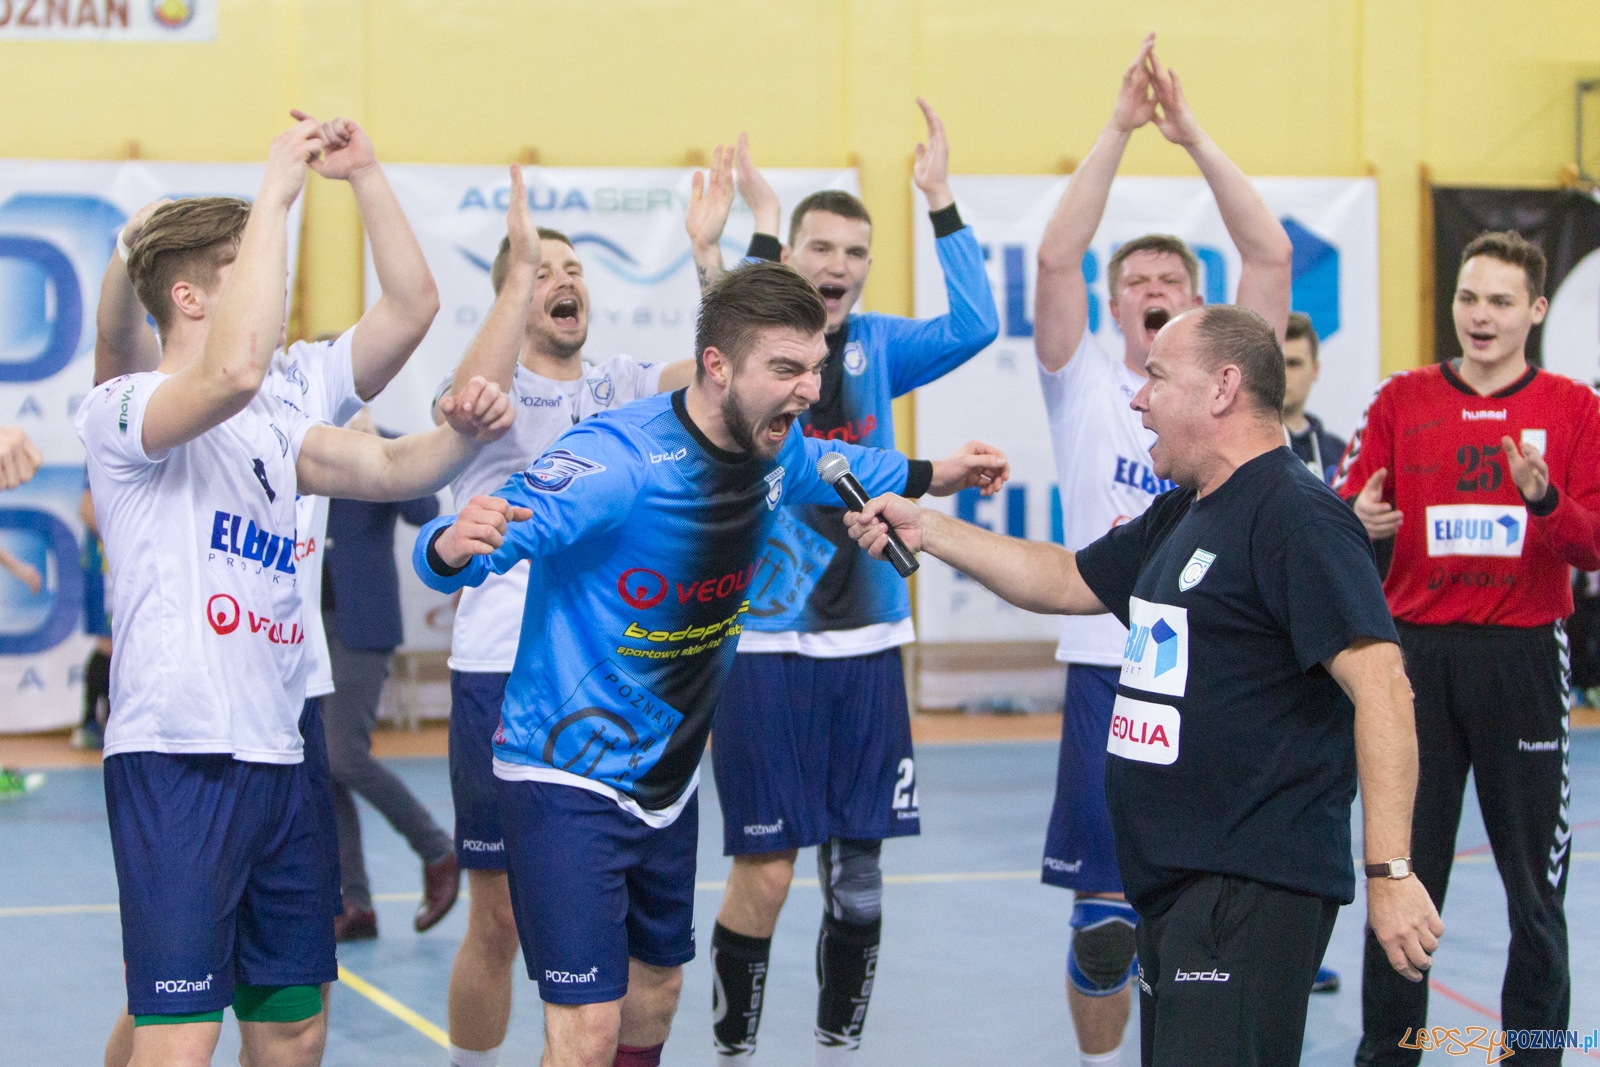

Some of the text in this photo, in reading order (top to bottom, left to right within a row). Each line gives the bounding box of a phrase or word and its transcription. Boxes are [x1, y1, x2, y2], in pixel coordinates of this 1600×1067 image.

[1462, 408, 1507, 421] hummel
[1114, 455, 1178, 495] ELB
[1456, 444, 1503, 492] 25
[1434, 518, 1494, 541] ELBUD
[208, 552, 297, 588] PROJKT
[676, 557, 761, 605] VEOLI
[616, 645, 680, 659] sportowy
[1123, 621, 1151, 664] BUD
[1110, 712, 1171, 748] EOLIA
[1518, 738, 1559, 751] hummel
